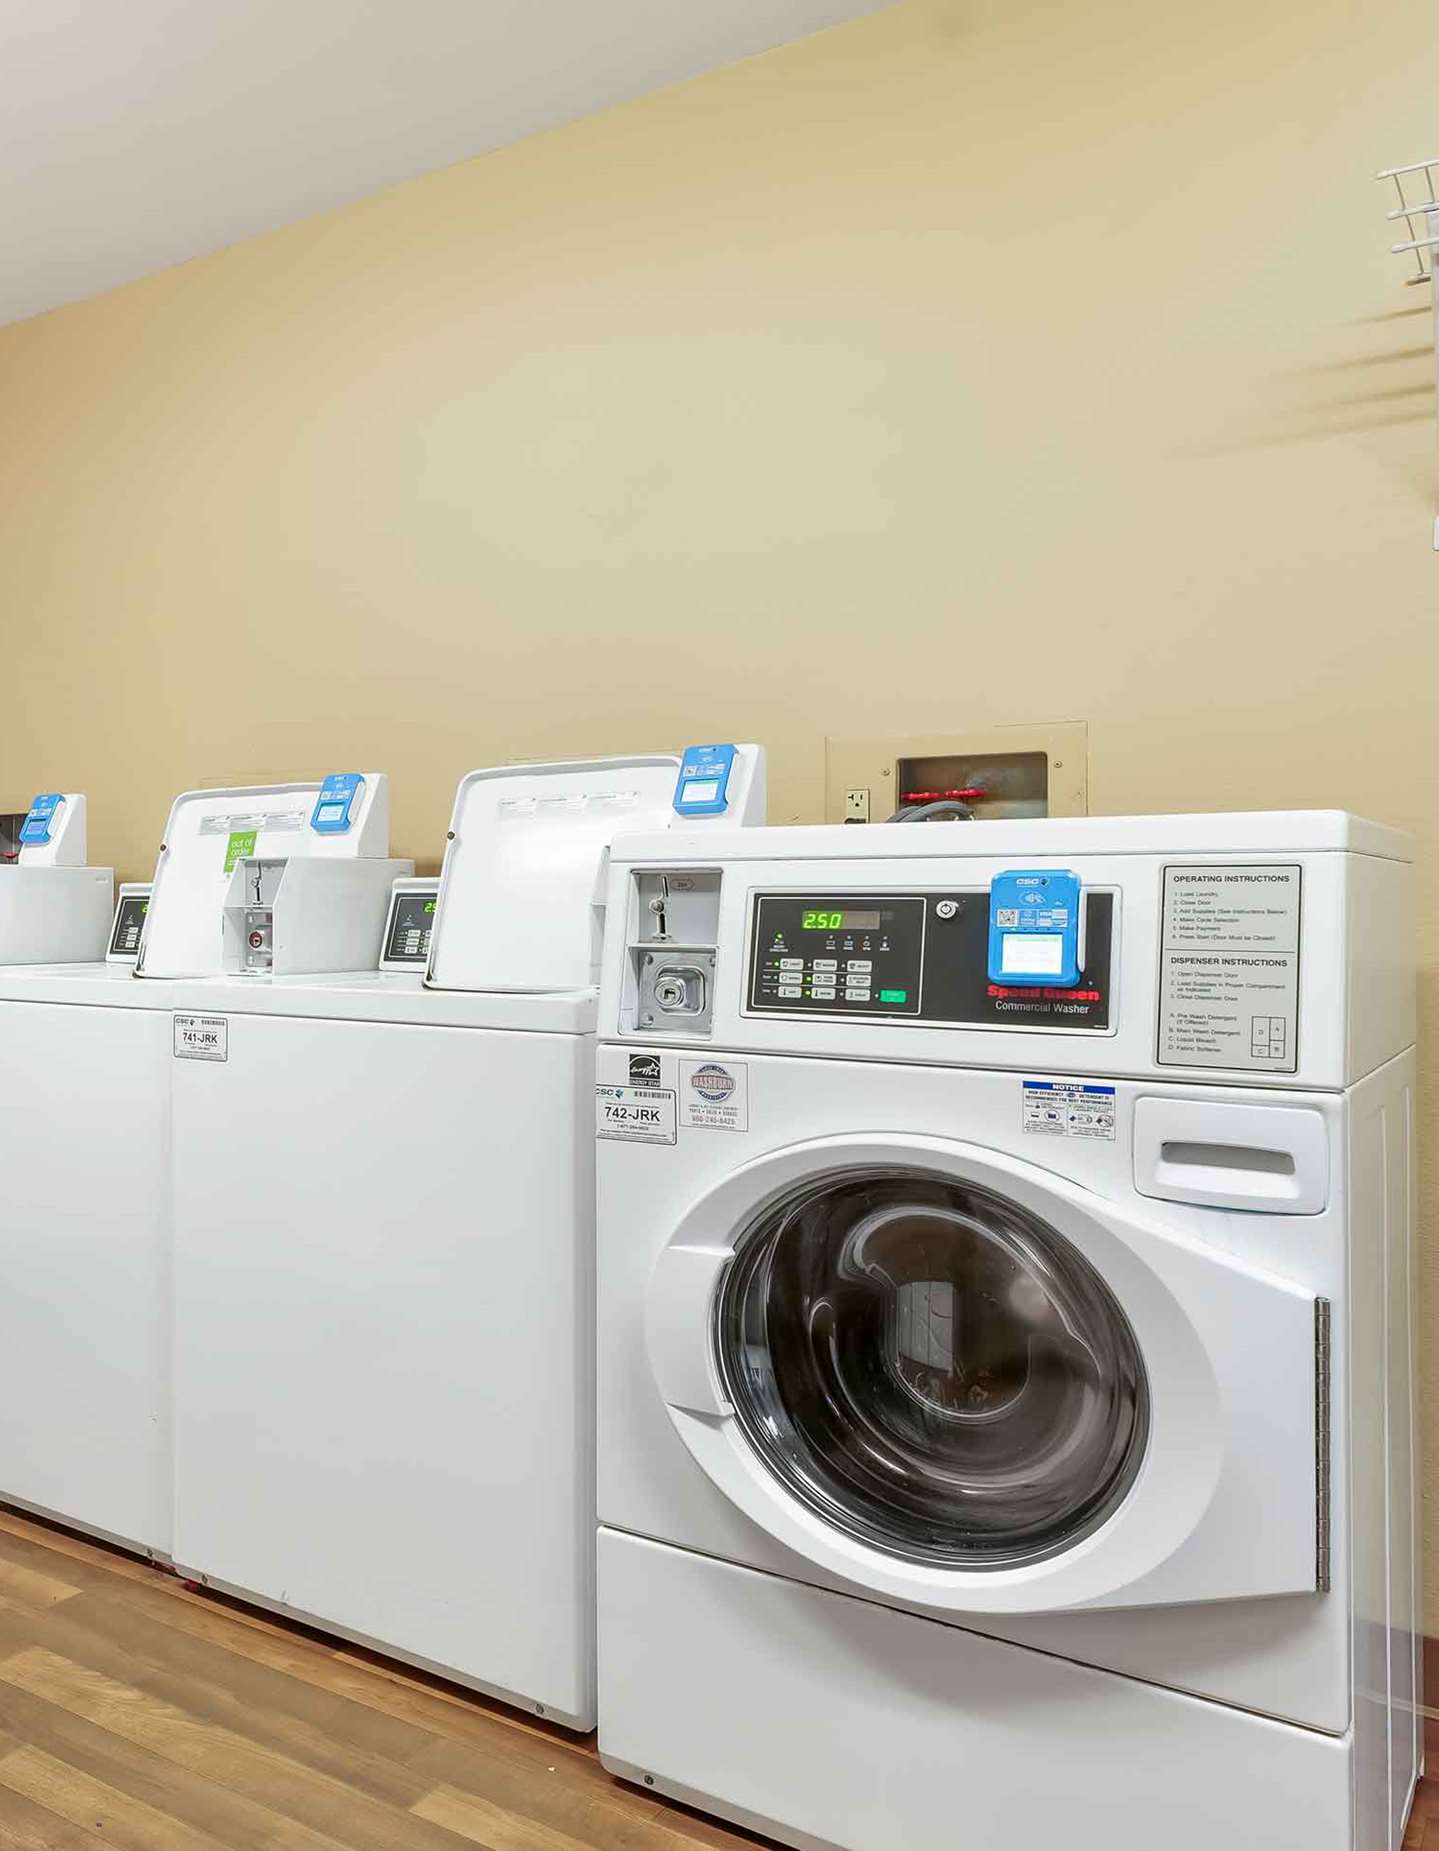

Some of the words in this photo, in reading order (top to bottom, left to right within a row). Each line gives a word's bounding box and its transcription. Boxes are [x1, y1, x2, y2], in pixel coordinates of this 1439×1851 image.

[1173, 875, 1223, 883] OPERATING
[1224, 875, 1290, 883] INSTRUCTIONS
[1221, 958, 1288, 967] INSTRUCTIONS
[995, 1000, 1051, 1013] Commercial
[1053, 1003, 1090, 1015] Washer
[183, 1032, 218, 1044] 741-JRK
[1052, 1084, 1085, 1092] NOTICE
[604, 1106, 661, 1122] 742-JRK
